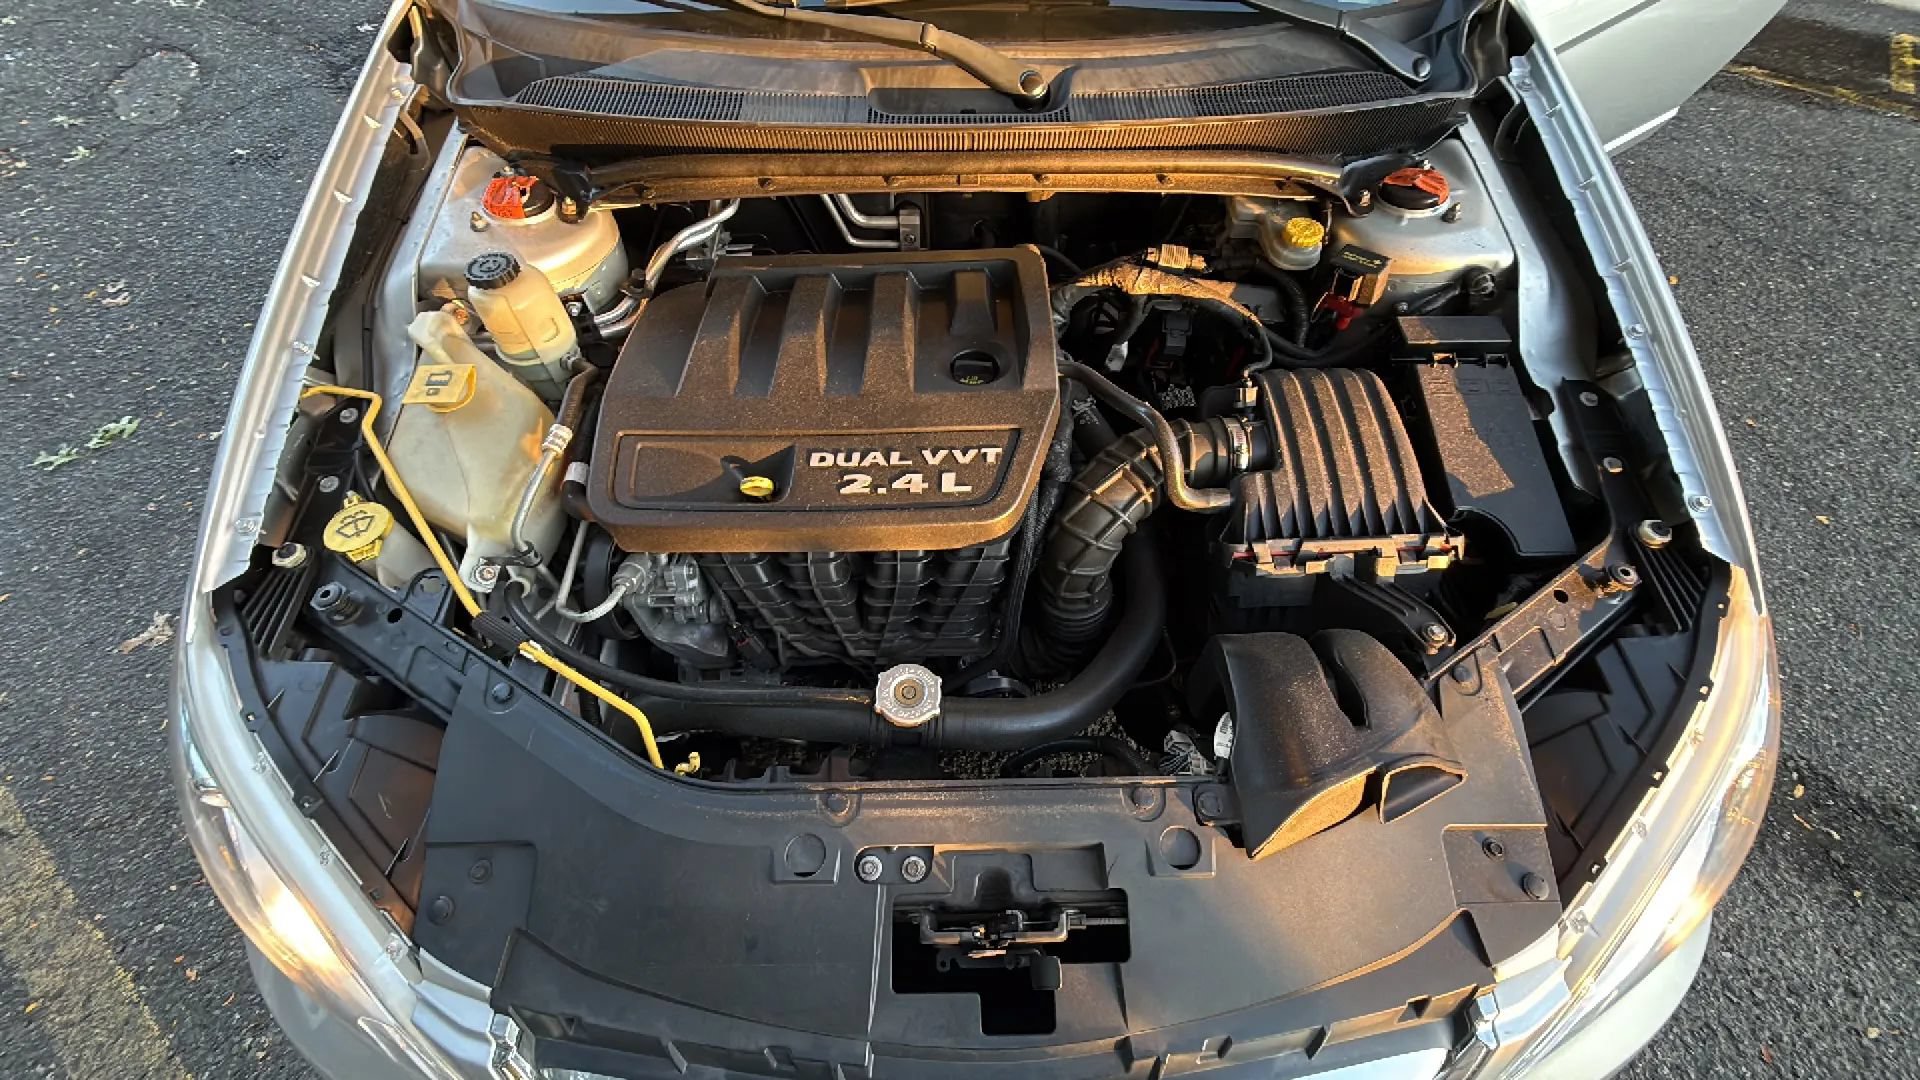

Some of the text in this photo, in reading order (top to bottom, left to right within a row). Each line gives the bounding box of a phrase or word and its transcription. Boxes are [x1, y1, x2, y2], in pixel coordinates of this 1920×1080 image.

[809, 447, 1003, 467] DUAL VVT
[839, 473, 929, 495] 2.4
